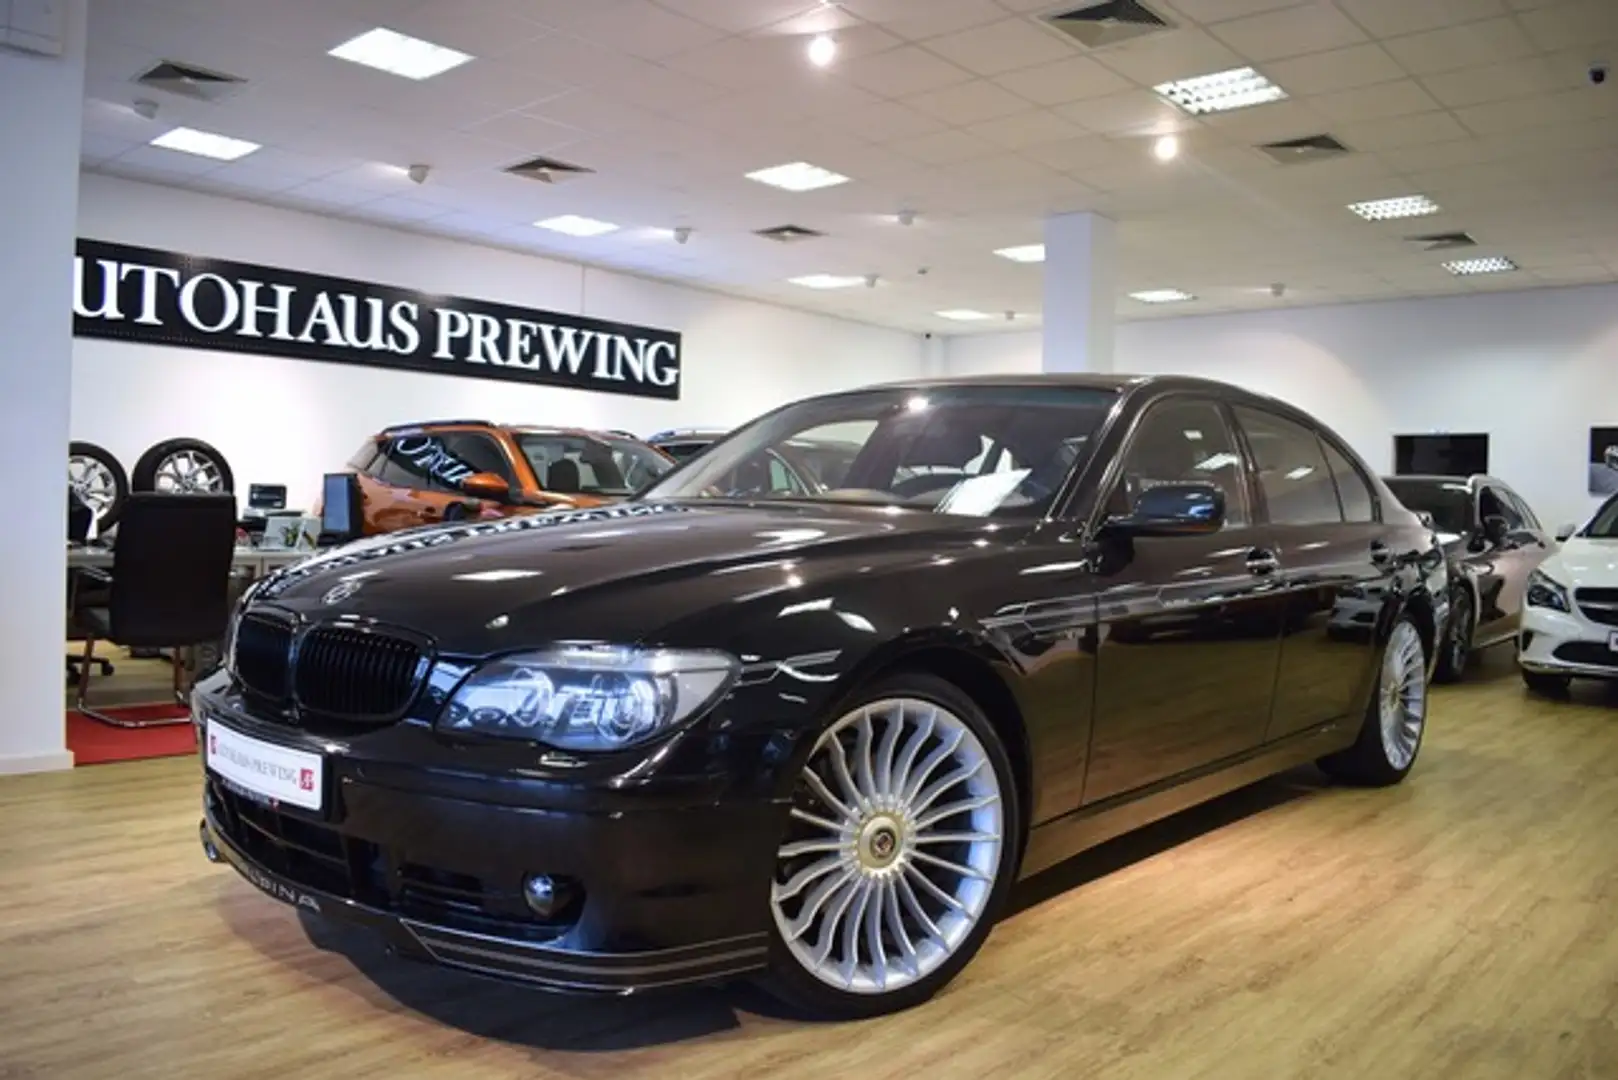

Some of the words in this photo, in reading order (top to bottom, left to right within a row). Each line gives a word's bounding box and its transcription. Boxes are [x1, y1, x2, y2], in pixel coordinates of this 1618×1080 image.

[73, 256, 420, 355] UTOHAUS
[432, 307, 679, 387] PREWING
[246, 865, 321, 912] PINA
